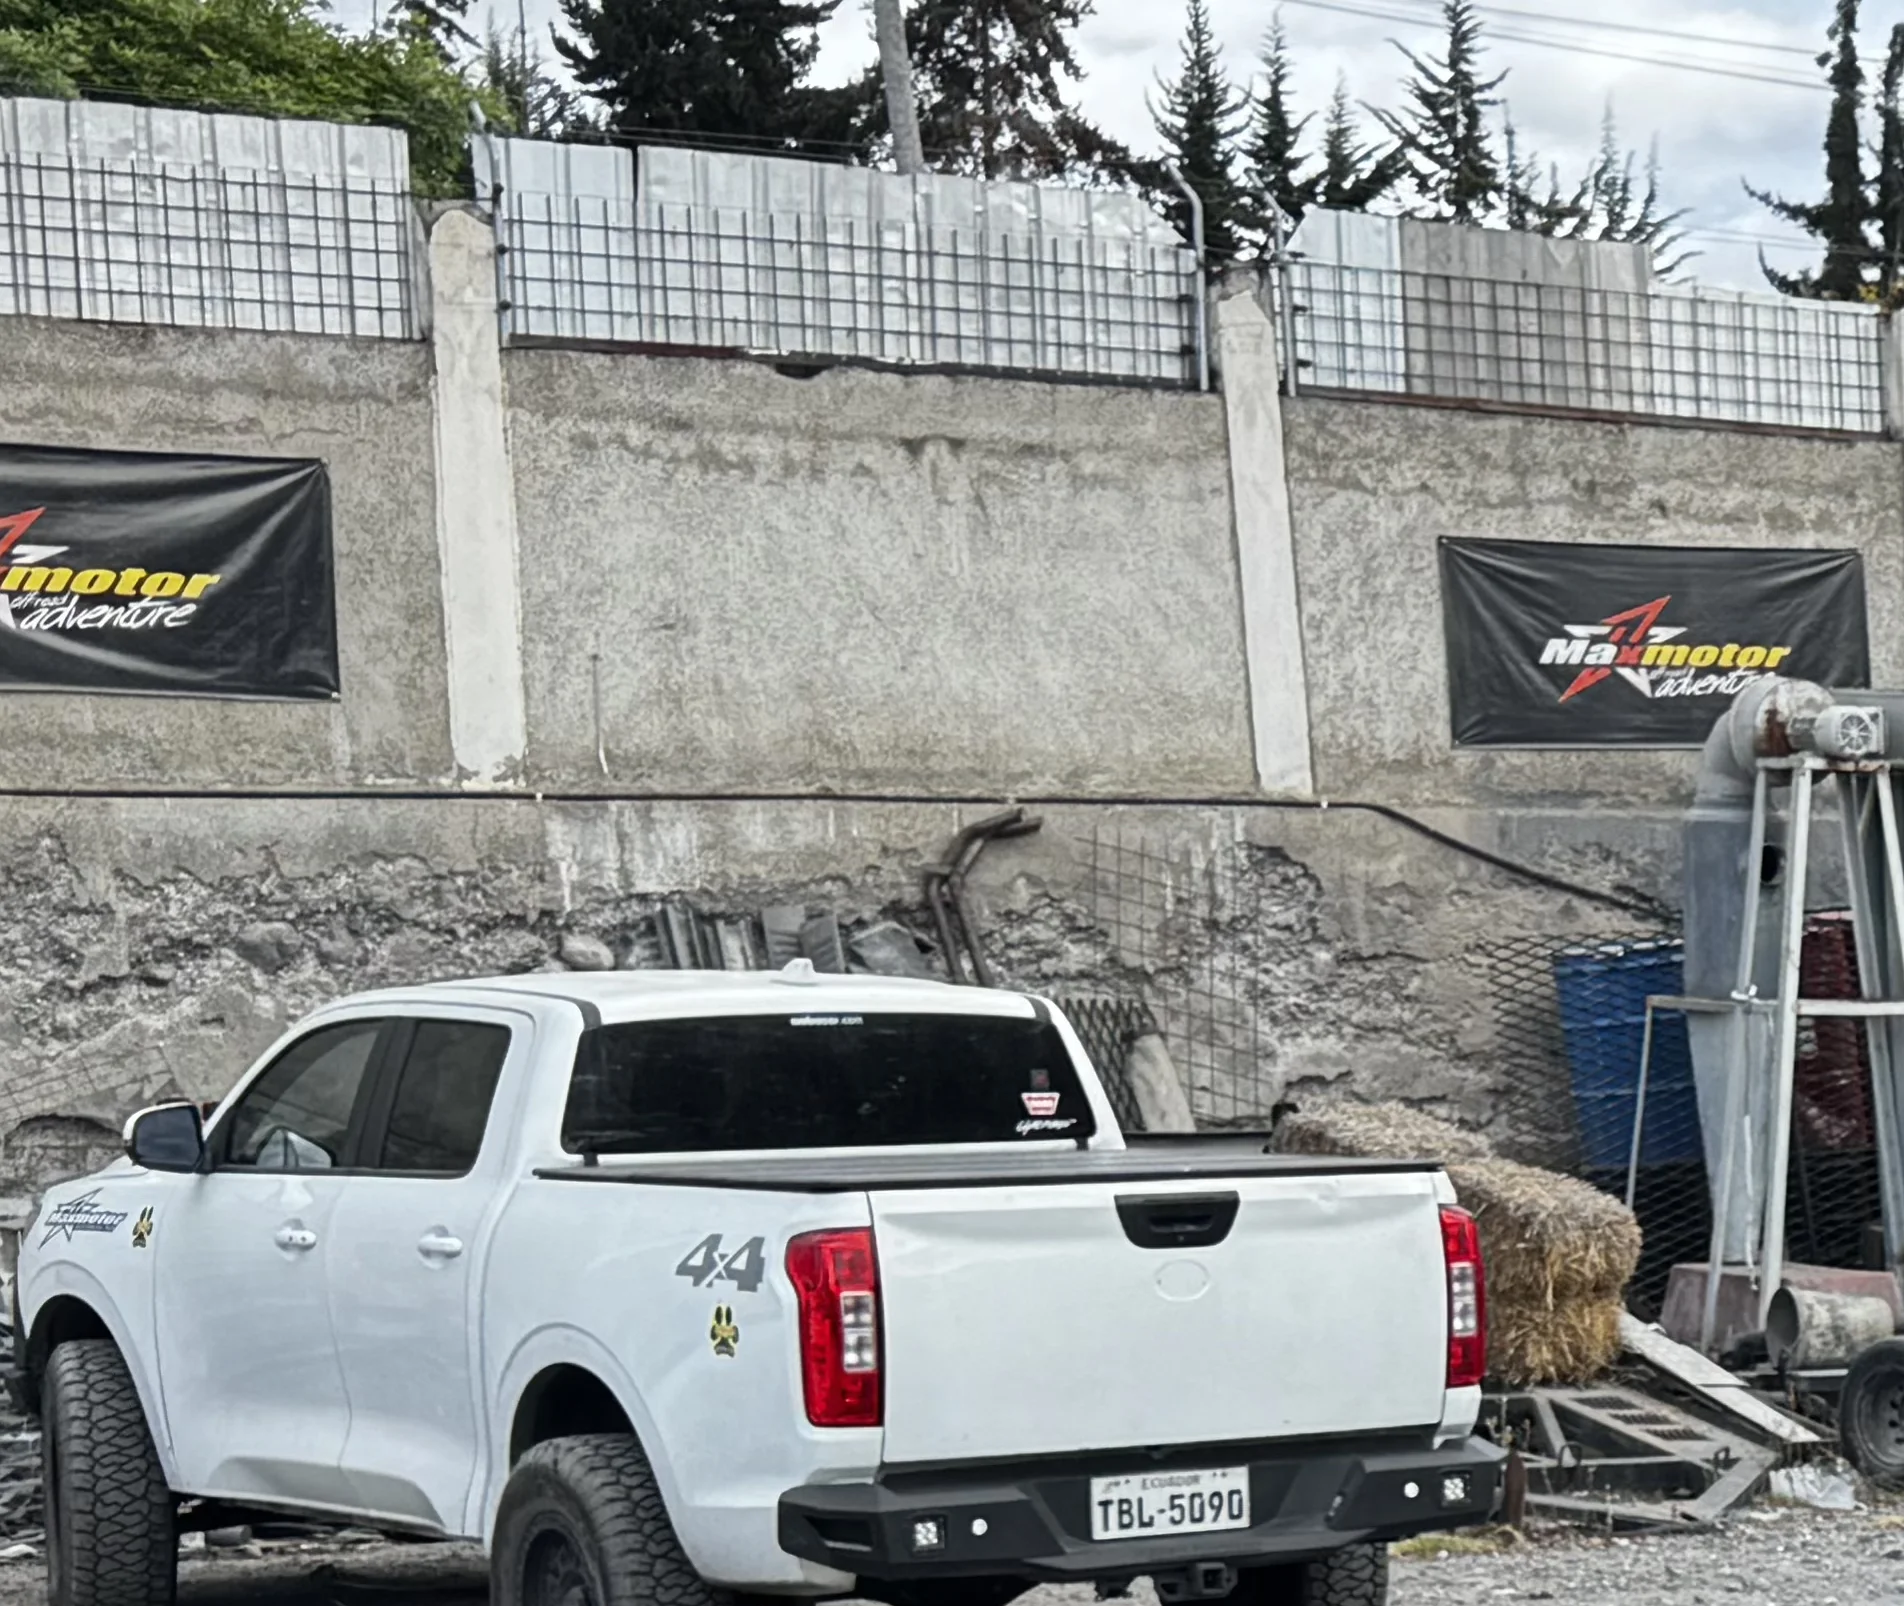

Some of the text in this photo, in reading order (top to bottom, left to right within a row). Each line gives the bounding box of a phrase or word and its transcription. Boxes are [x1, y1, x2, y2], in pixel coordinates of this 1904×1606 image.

[0, 566, 221, 599] motor
[20, 594, 197, 630] adventure
[1539, 638, 1791, 668] Maxmotor
[1655, 667, 1775, 697] adventu
[1141, 1475, 1201, 1490] ECUADOR
[1097, 1489, 1244, 1532] TBL-5090
